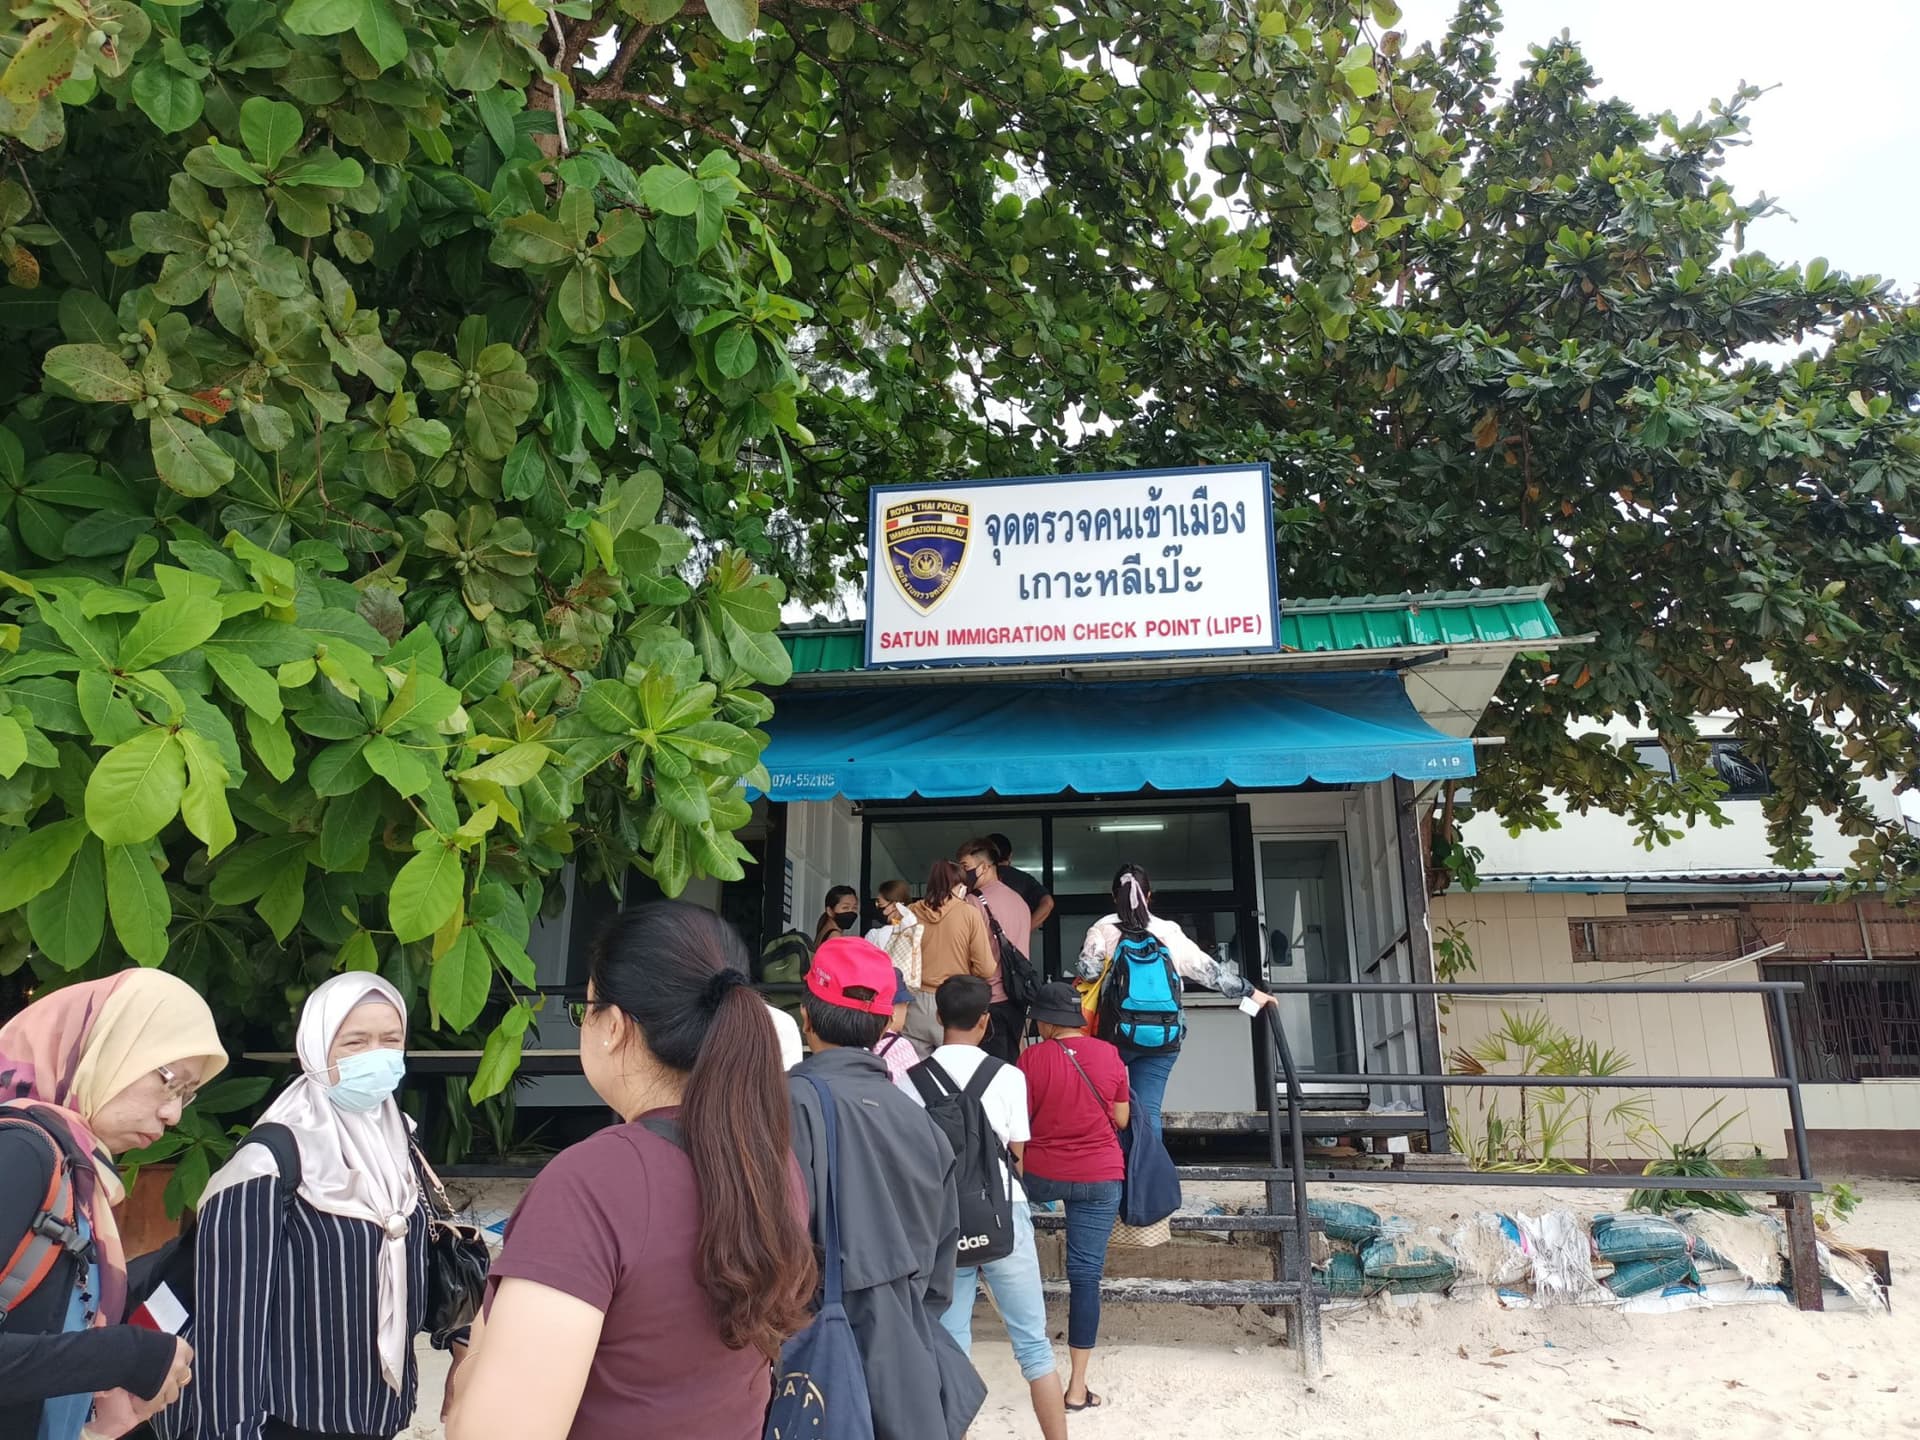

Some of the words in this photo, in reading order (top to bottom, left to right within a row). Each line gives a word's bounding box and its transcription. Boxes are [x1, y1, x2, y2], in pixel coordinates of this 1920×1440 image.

[889, 504, 915, 517] ROYAL
[916, 502, 936, 511] THAI
[936, 502, 966, 513] POLICE
[888, 525, 937, 540] IMMIGRATION
[936, 525, 965, 538] BUREAU
[985, 485, 1246, 566] จุดตรวจคนเข้าเมือง
[1019, 544, 1203, 600] เกาะหลีเป๊ะ
[880, 630, 939, 649] SATUN
[946, 624, 1066, 646] IMMIGRATION
[1073, 621, 1137, 641] CHECK
[1145, 618, 1201, 637] POINT
[1207, 614, 1262, 637] (LIPE)
[957, 1234, 990, 1251] das
